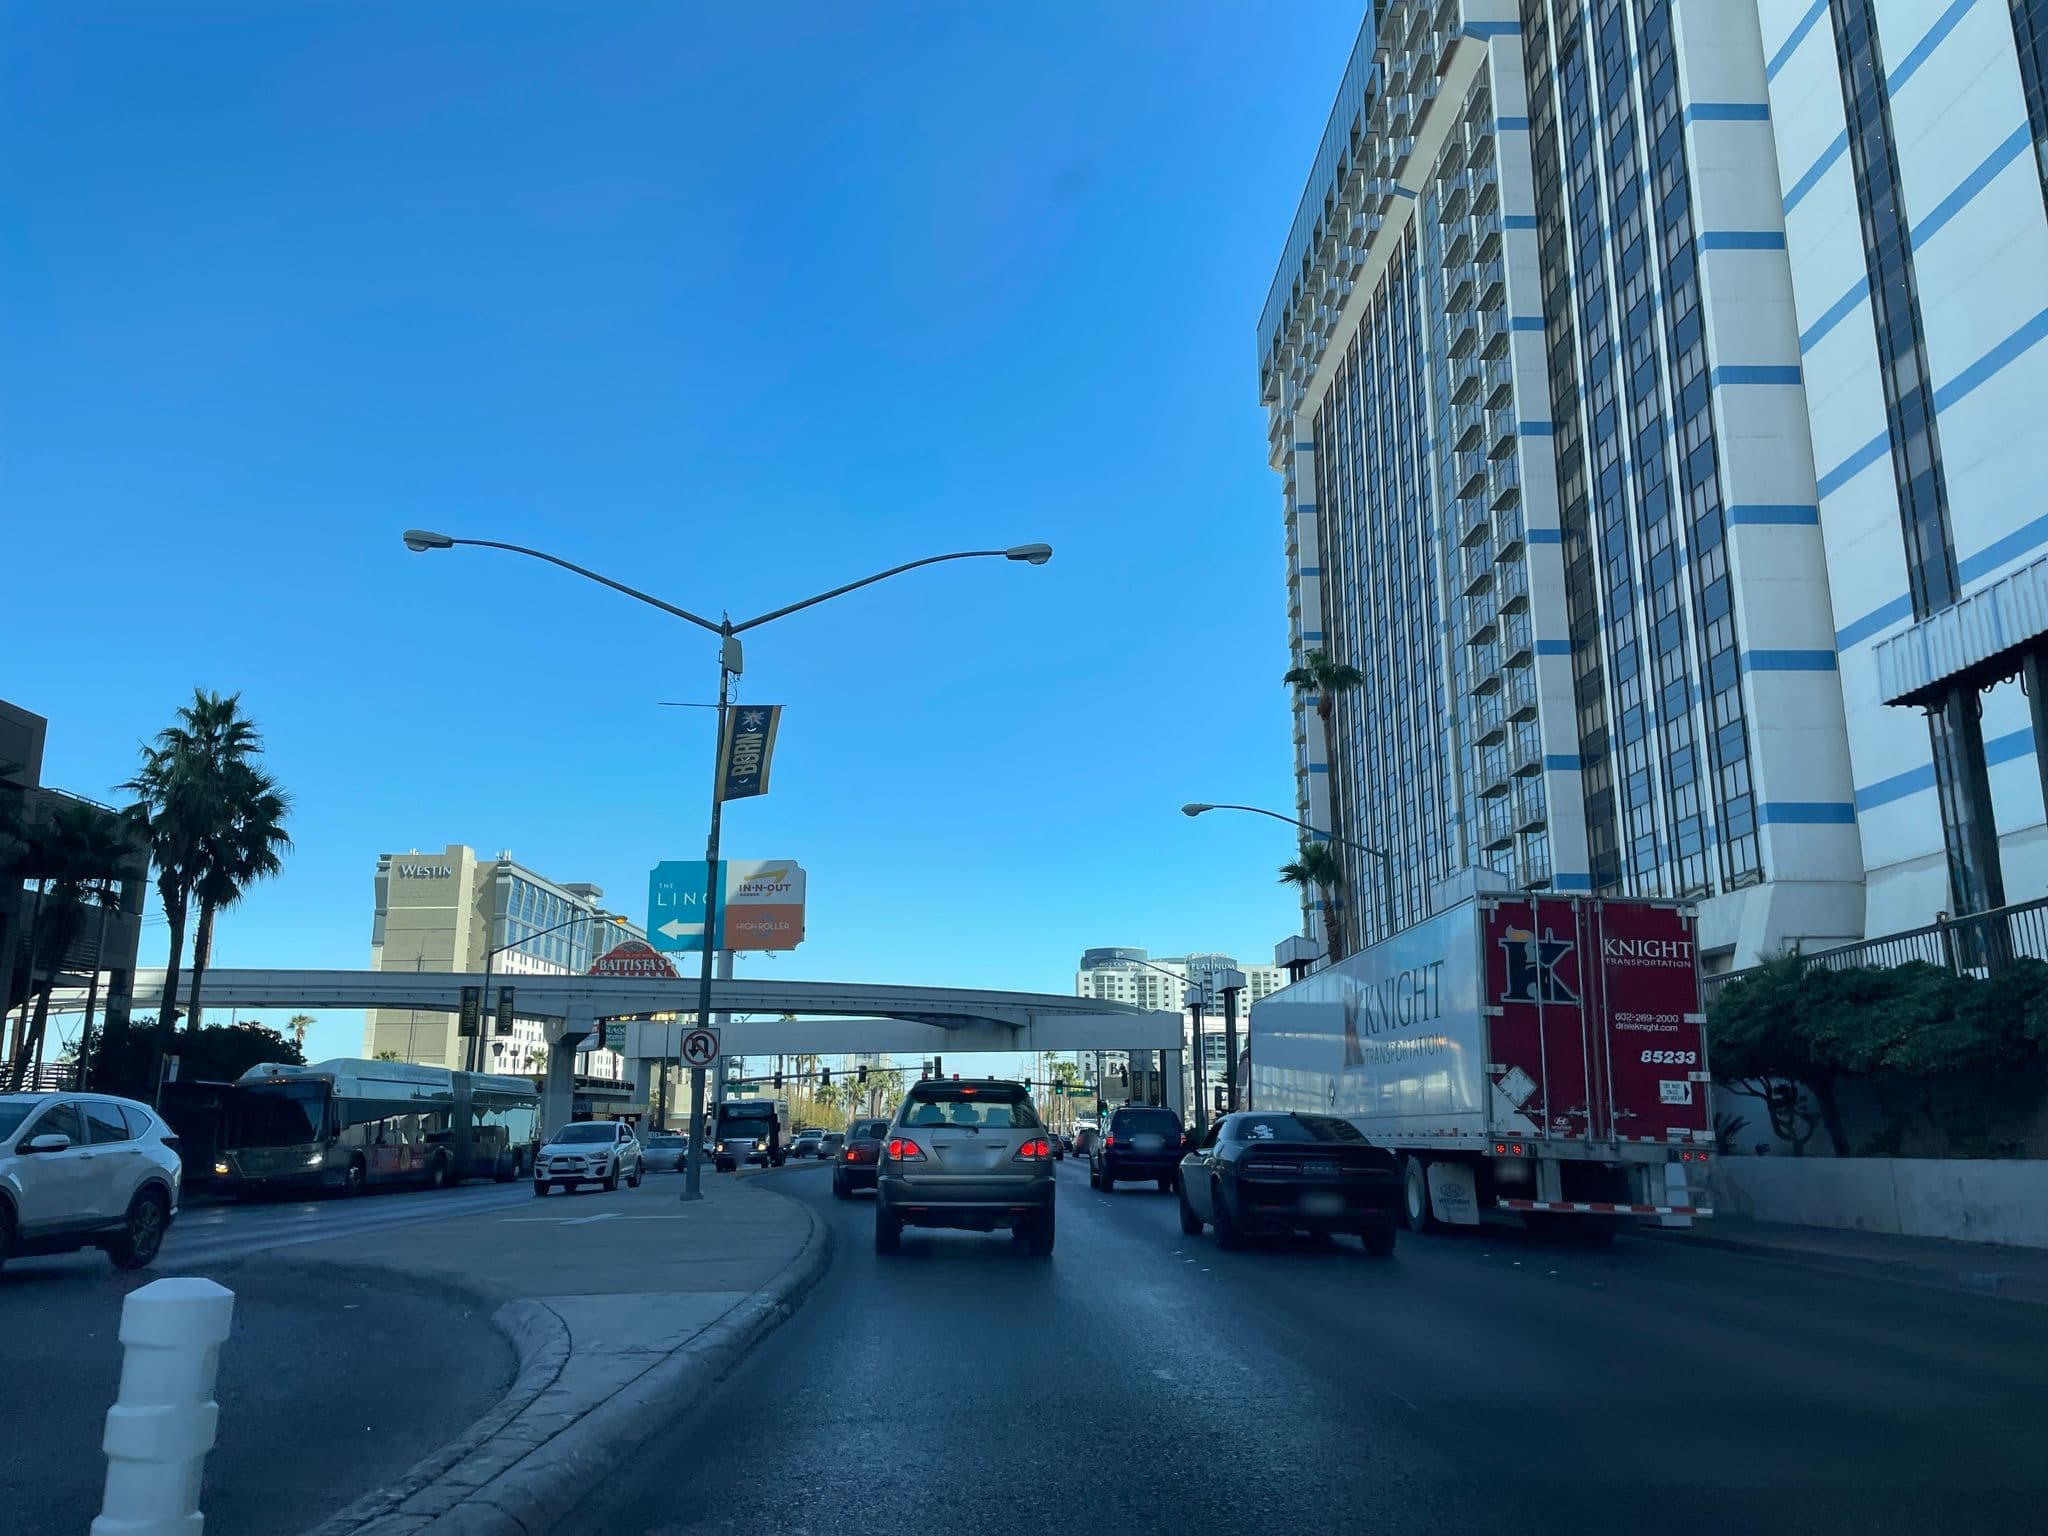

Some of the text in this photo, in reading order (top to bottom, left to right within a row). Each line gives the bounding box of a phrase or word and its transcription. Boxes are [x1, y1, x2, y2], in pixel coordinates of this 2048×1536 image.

[731, 733, 763, 776] BORN
[738, 883, 791, 893] IN-N-OUT
[657, 891, 708, 906] LIN
[735, 920, 789, 931] HIGH ROLLER
[1603, 938, 1692, 960] KNIGHT
[599, 958, 665, 971] BATTISTA'S
[1191, 962, 1236, 971] PLATINUM
[1604, 957, 1691, 969] TRANSPORTATION
[1364, 959, 1445, 1037] KNIGHT
[1365, 1033, 1444, 1065] TRANSPORTATION
[1641, 1050, 1697, 1065] 85233
